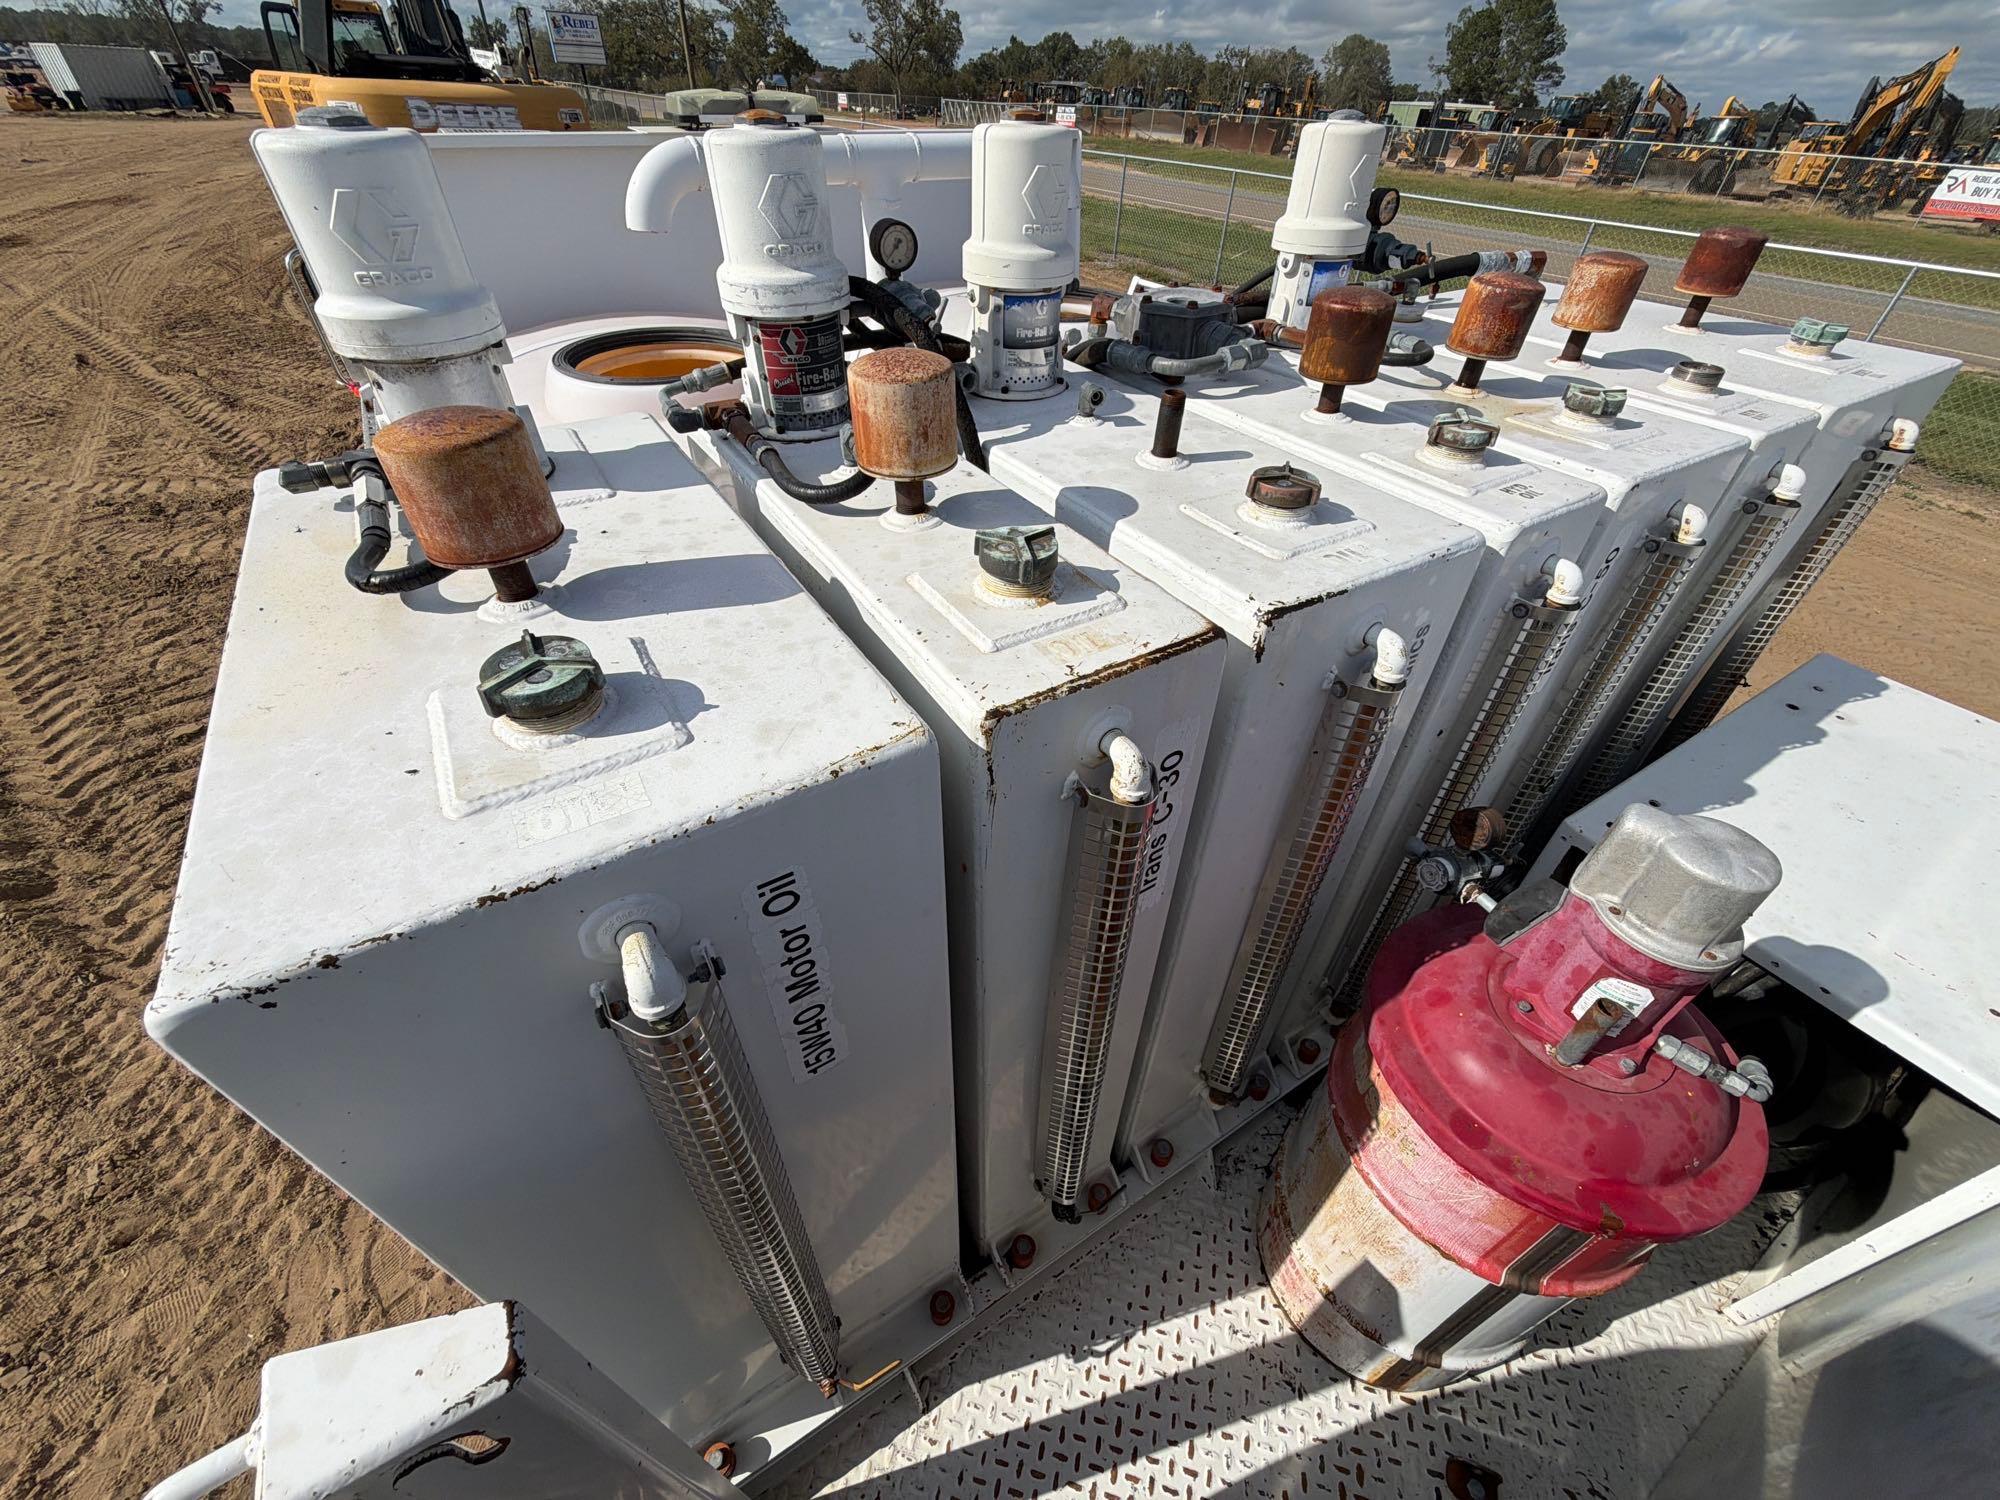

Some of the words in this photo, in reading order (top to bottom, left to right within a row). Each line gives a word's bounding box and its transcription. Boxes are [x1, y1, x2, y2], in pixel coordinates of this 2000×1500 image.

[561, 14, 598, 29] REBEL
[405, 96, 523, 130] DEERE
[1970, 185, 1994, 199] BUY
[763, 241, 823, 257] GRACO
[353, 266, 434, 287] GRACO
[781, 355, 810, 363] GRACO
[795, 364, 840, 386] Fire-Ball
[1152, 750, 1184, 826] C-30
[756, 871, 801, 917] Oil
[779, 924, 821, 1005] Motor
[793, 1003, 836, 1075] 15W40
